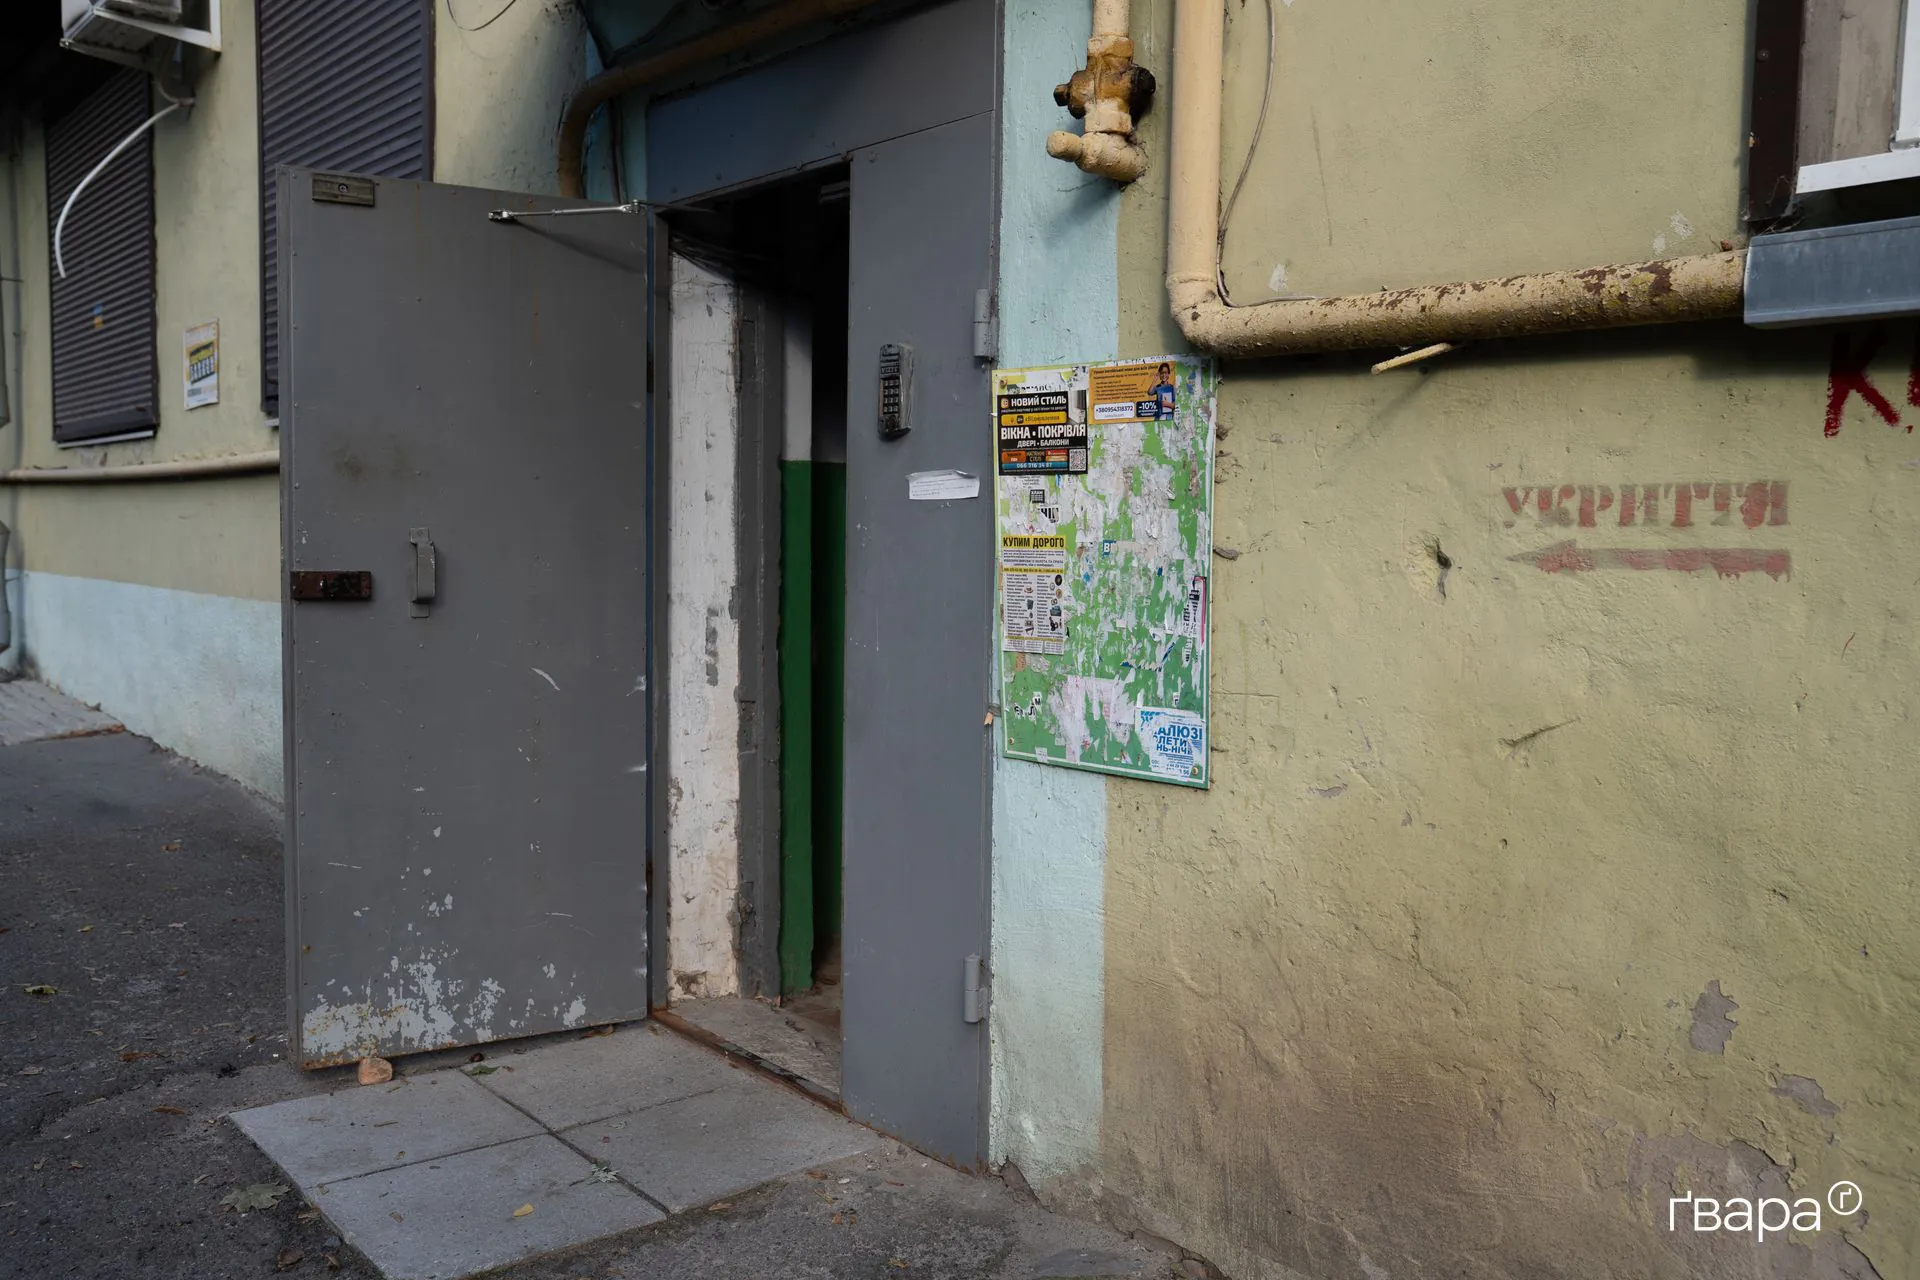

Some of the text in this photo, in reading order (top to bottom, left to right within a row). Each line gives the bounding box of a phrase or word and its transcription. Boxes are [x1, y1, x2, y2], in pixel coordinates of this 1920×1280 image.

[1824, 329, 1920, 438] К
[1011, 395, 1066, 407] НОВИЙ СТИЛЬ
[1138, 402, 1157, 410] -10%
[1001, 424, 1086, 440] ВІКНА ПОКРІВЛЯ
[1003, 538, 1064, 548] КУПИМ ДОРОГО
[1154, 726, 1202, 740] АЛЮЗІ
